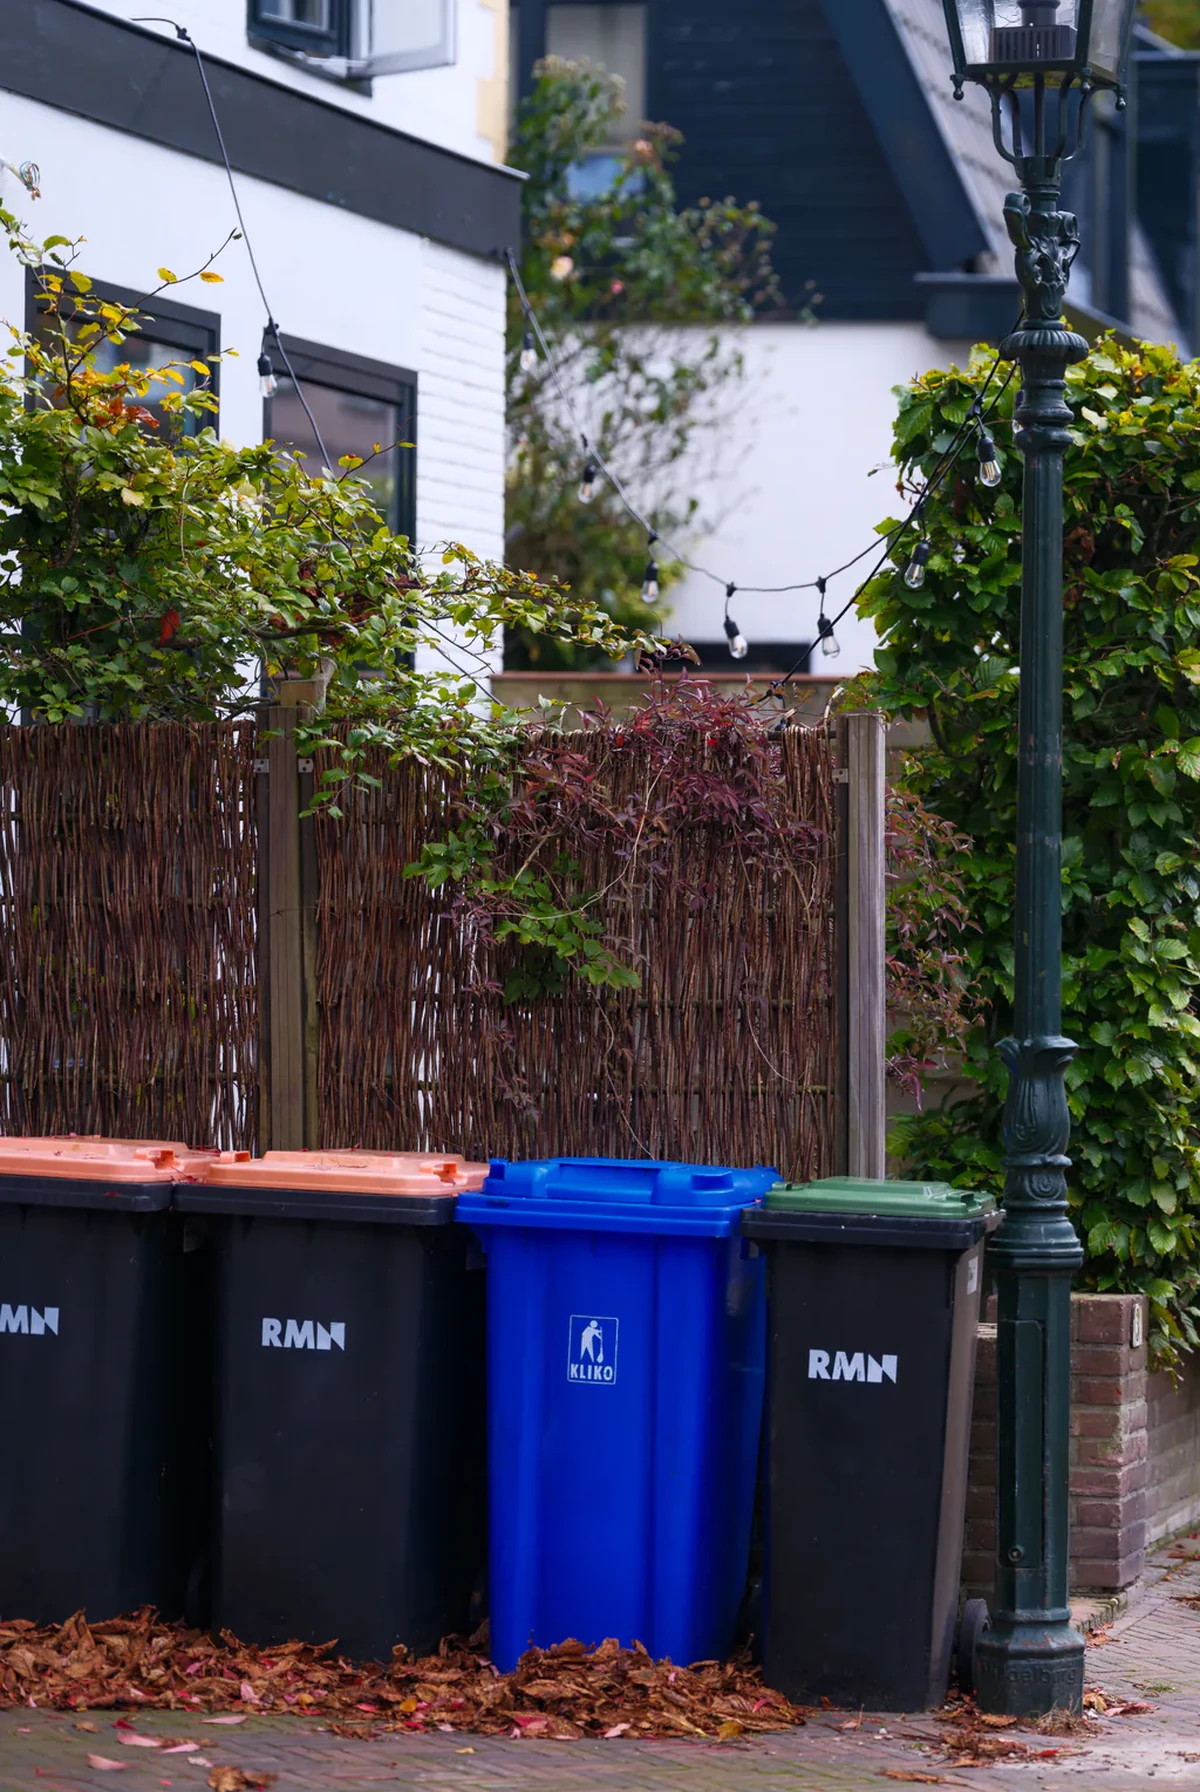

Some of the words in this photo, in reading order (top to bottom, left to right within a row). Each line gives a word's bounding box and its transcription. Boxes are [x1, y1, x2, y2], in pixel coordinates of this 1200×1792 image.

[0, 1303, 60, 1336] MN
[261, 1317, 346, 1351] RMN
[570, 1363, 613, 1381] KLIKO
[807, 1348, 898, 1384] RMN
[977, 1661, 1077, 1686] Midelburg
